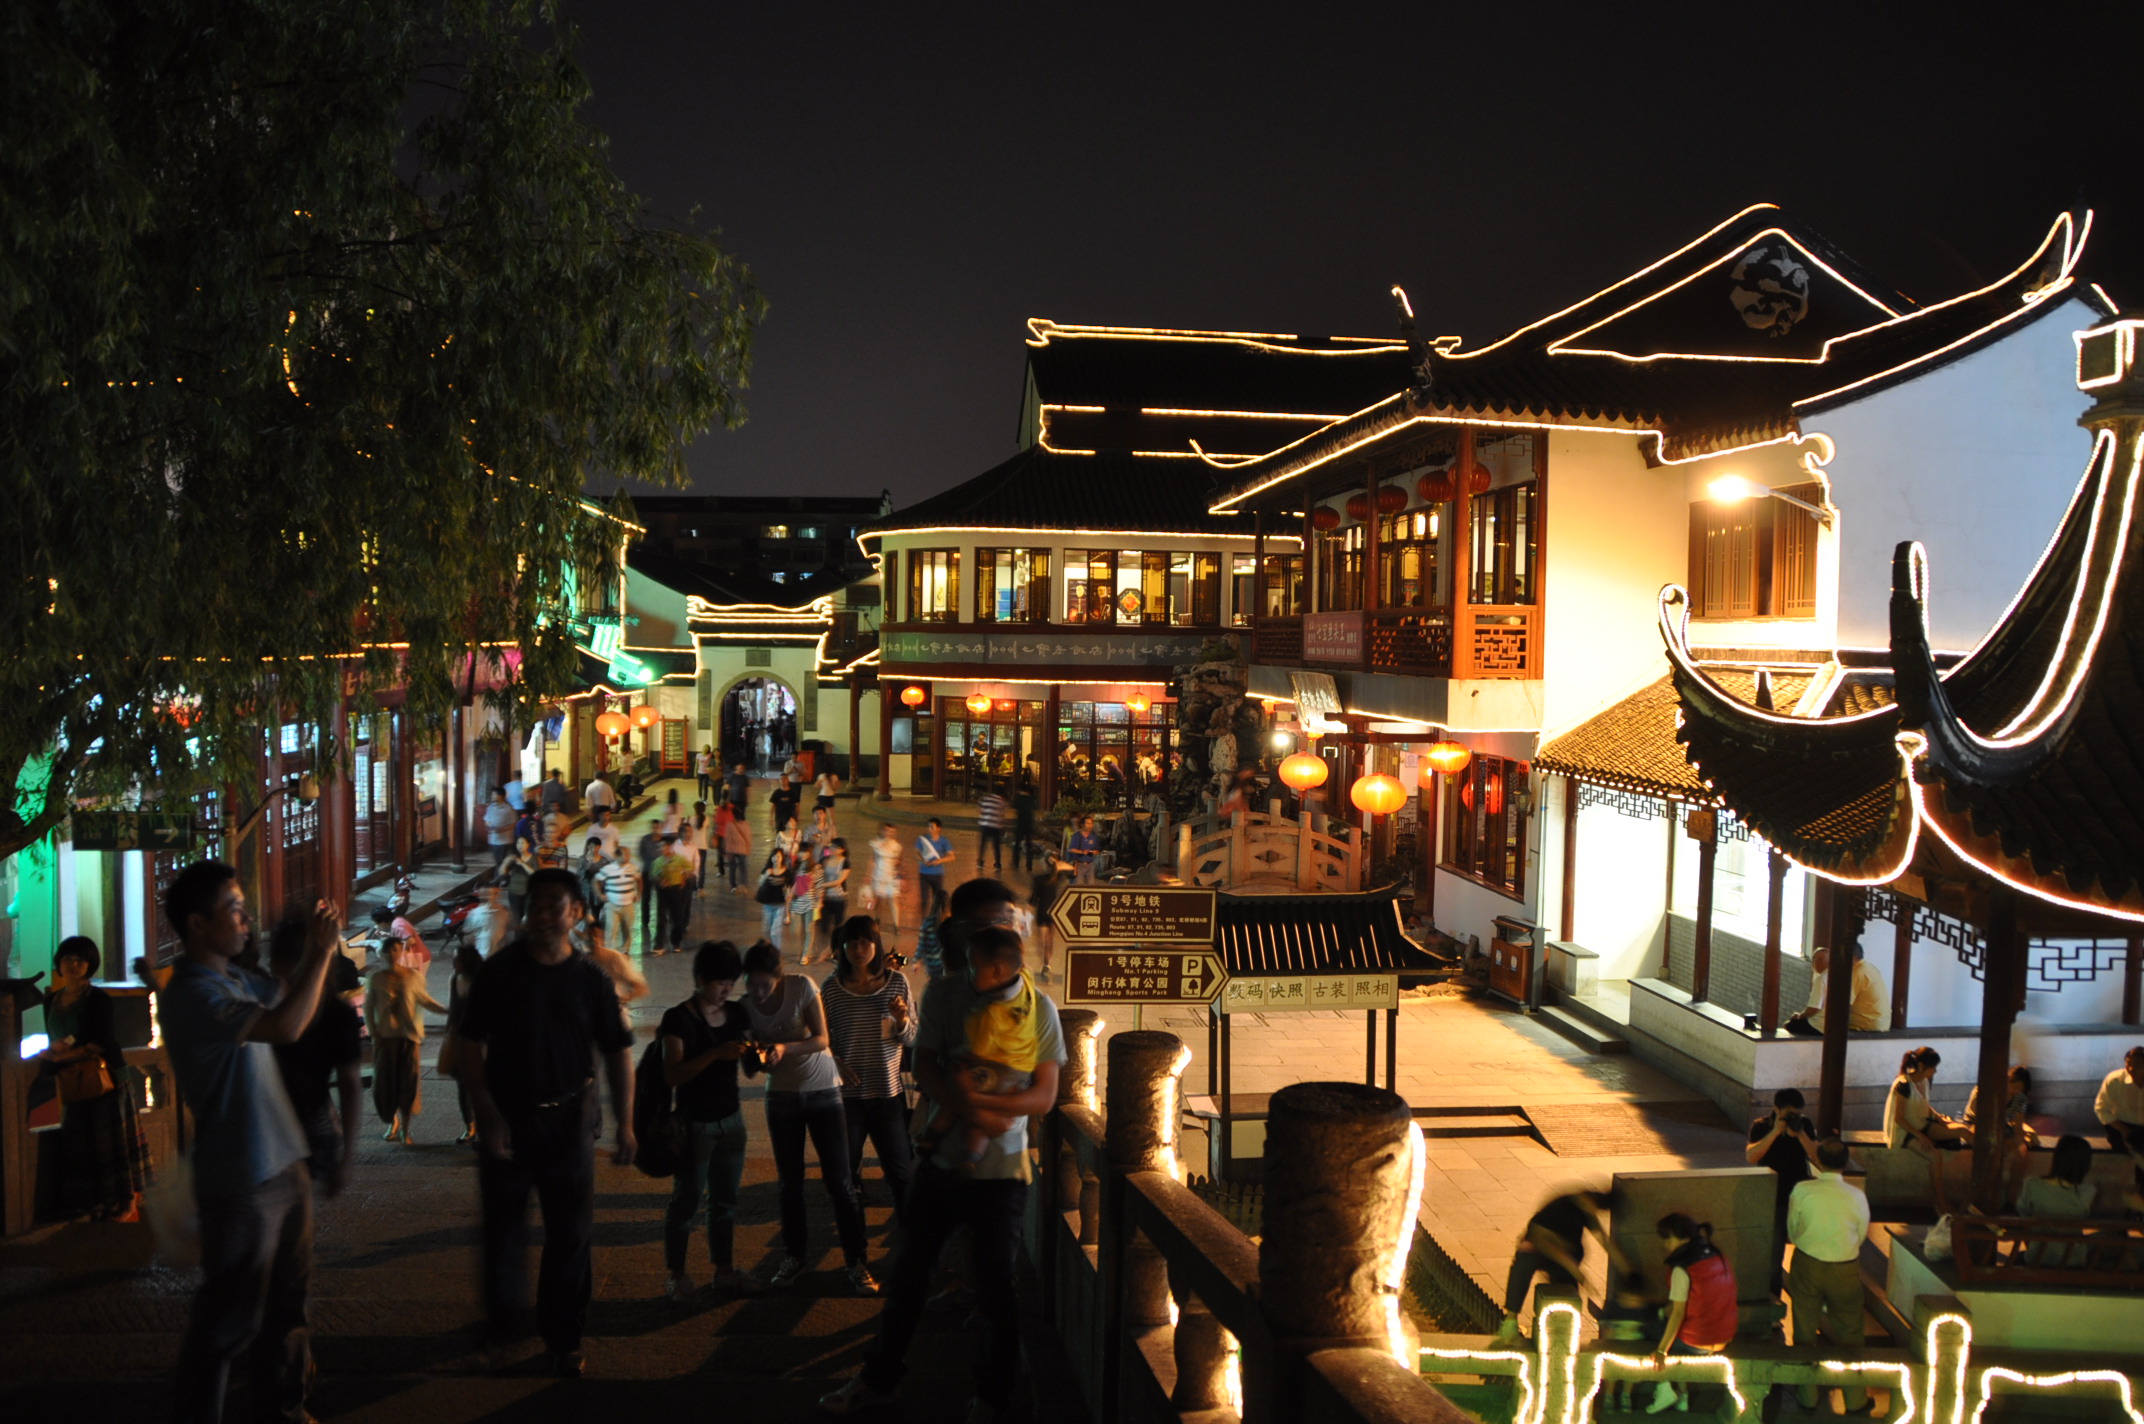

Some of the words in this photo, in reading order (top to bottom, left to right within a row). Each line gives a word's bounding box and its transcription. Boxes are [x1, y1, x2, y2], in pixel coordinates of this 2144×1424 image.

[1110, 894, 1161, 907] 9号地铁
[1107, 956, 1170, 968] 1号停车场
[1142, 968, 1168, 976] Parking
[1087, 977, 1168, 989] 闵行体育公园
